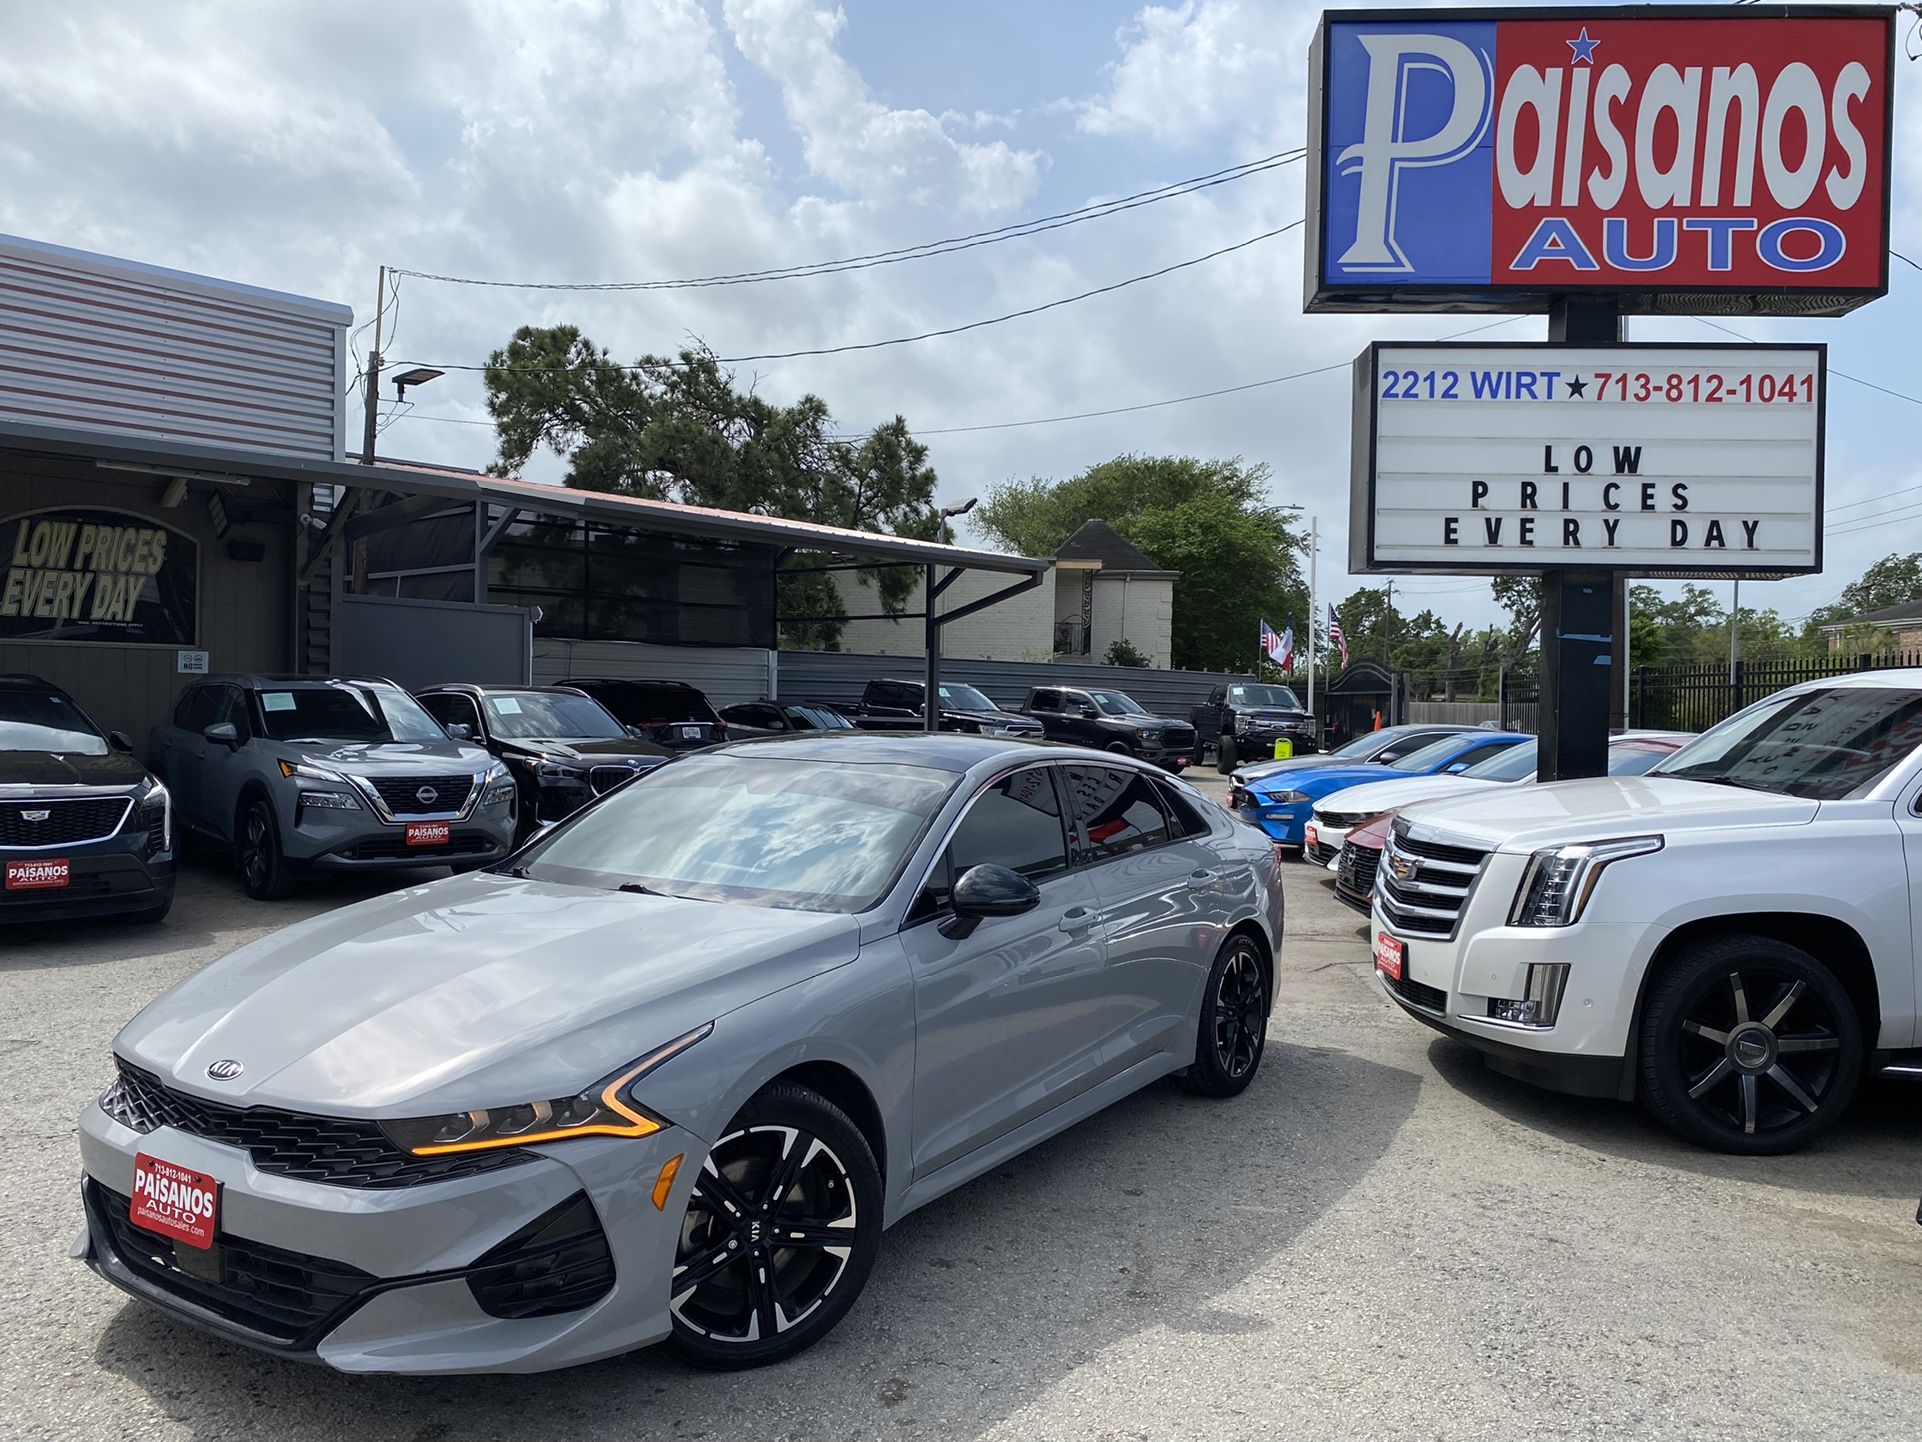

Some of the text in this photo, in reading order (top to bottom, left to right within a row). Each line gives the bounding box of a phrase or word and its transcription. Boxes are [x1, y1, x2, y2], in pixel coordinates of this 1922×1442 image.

[1336, 28, 1872, 273] Paisanos
[1509, 216, 1847, 273] AUTO
[1381, 370, 1815, 403] 2212 WIRT 713-812-1041
[1545, 445, 1642, 475] LOW
[1471, 481, 1689, 511] PRICES
[12, 519, 168, 576] LOW PRICES
[1445, 517, 1759, 549] EVERY DAY
[0, 569, 147, 622] EVERY DAY
[210, 1061, 237, 1076] KIA
[154, 1163, 191, 1184] 713-812-1041
[137, 1206, 205, 1237] paisanosautosales.com
[146, 1199, 196, 1224] AUTO
[751, 1221, 760, 1242] KIA
